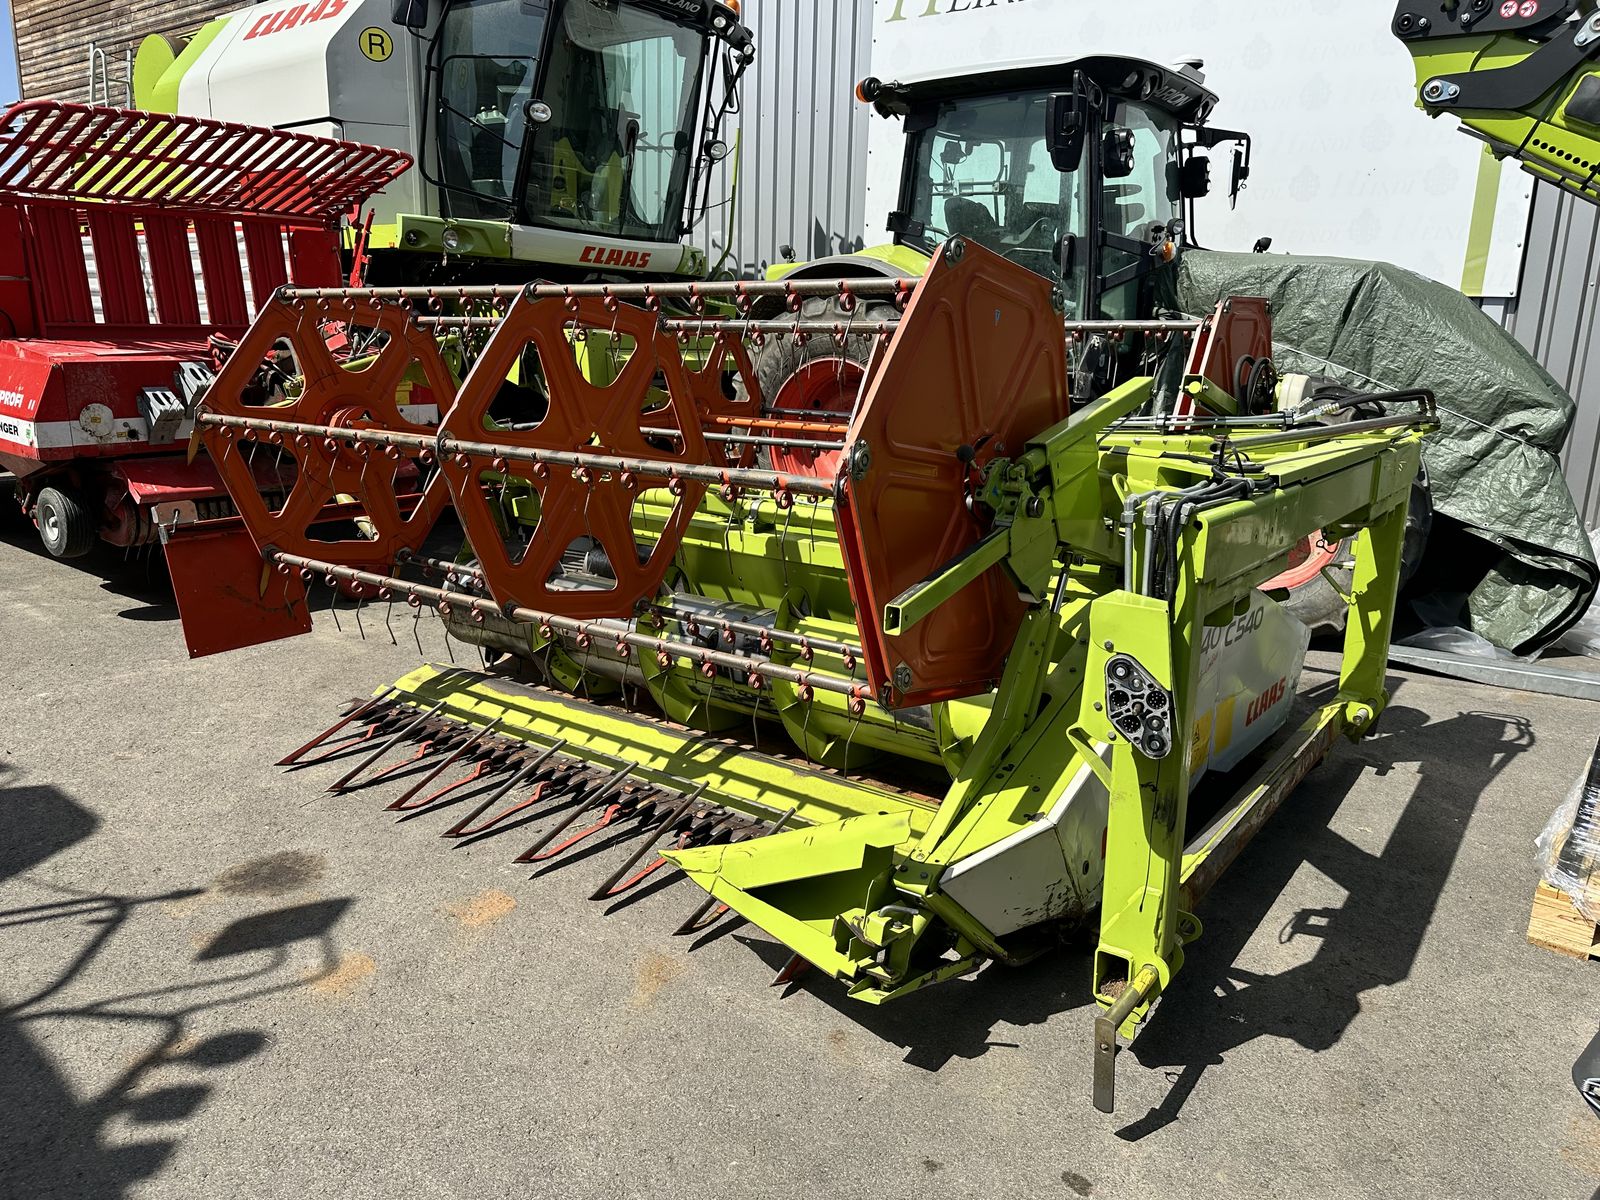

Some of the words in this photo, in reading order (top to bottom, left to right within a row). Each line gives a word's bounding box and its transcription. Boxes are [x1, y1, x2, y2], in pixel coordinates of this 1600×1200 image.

[243, 0, 348, 41] CLAAS
[368, 33, 386, 56] R
[579, 246, 652, 269] CLAAS
[1224, 605, 1264, 647] C540
[1245, 675, 1286, 728] CLAAS
